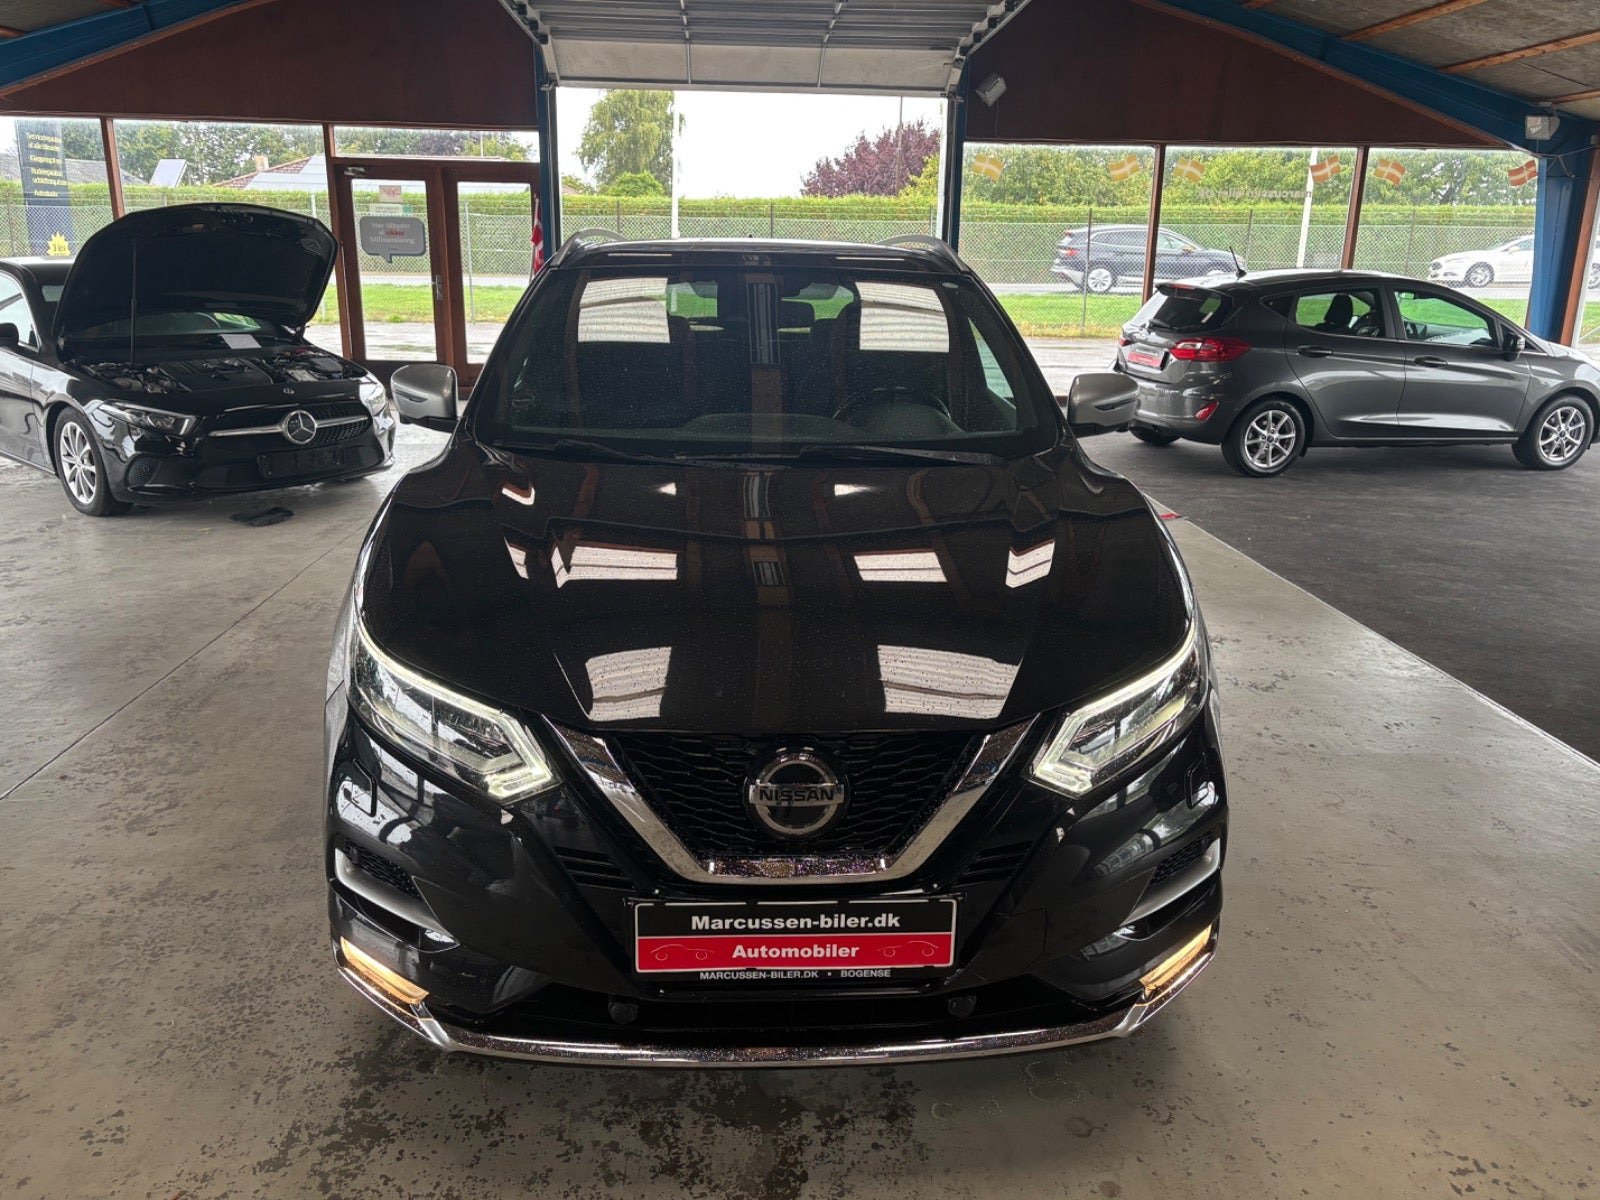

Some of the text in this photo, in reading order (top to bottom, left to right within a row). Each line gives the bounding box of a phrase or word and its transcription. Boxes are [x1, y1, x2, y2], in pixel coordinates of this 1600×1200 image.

[760, 789, 834, 801] NISSAN
[691, 913, 900, 930] Marcussen-biler.dk
[732, 944, 859, 959] Automobiler
[700, 969, 891, 980] MARCUSSEN-BILER.DK BOGENSE
